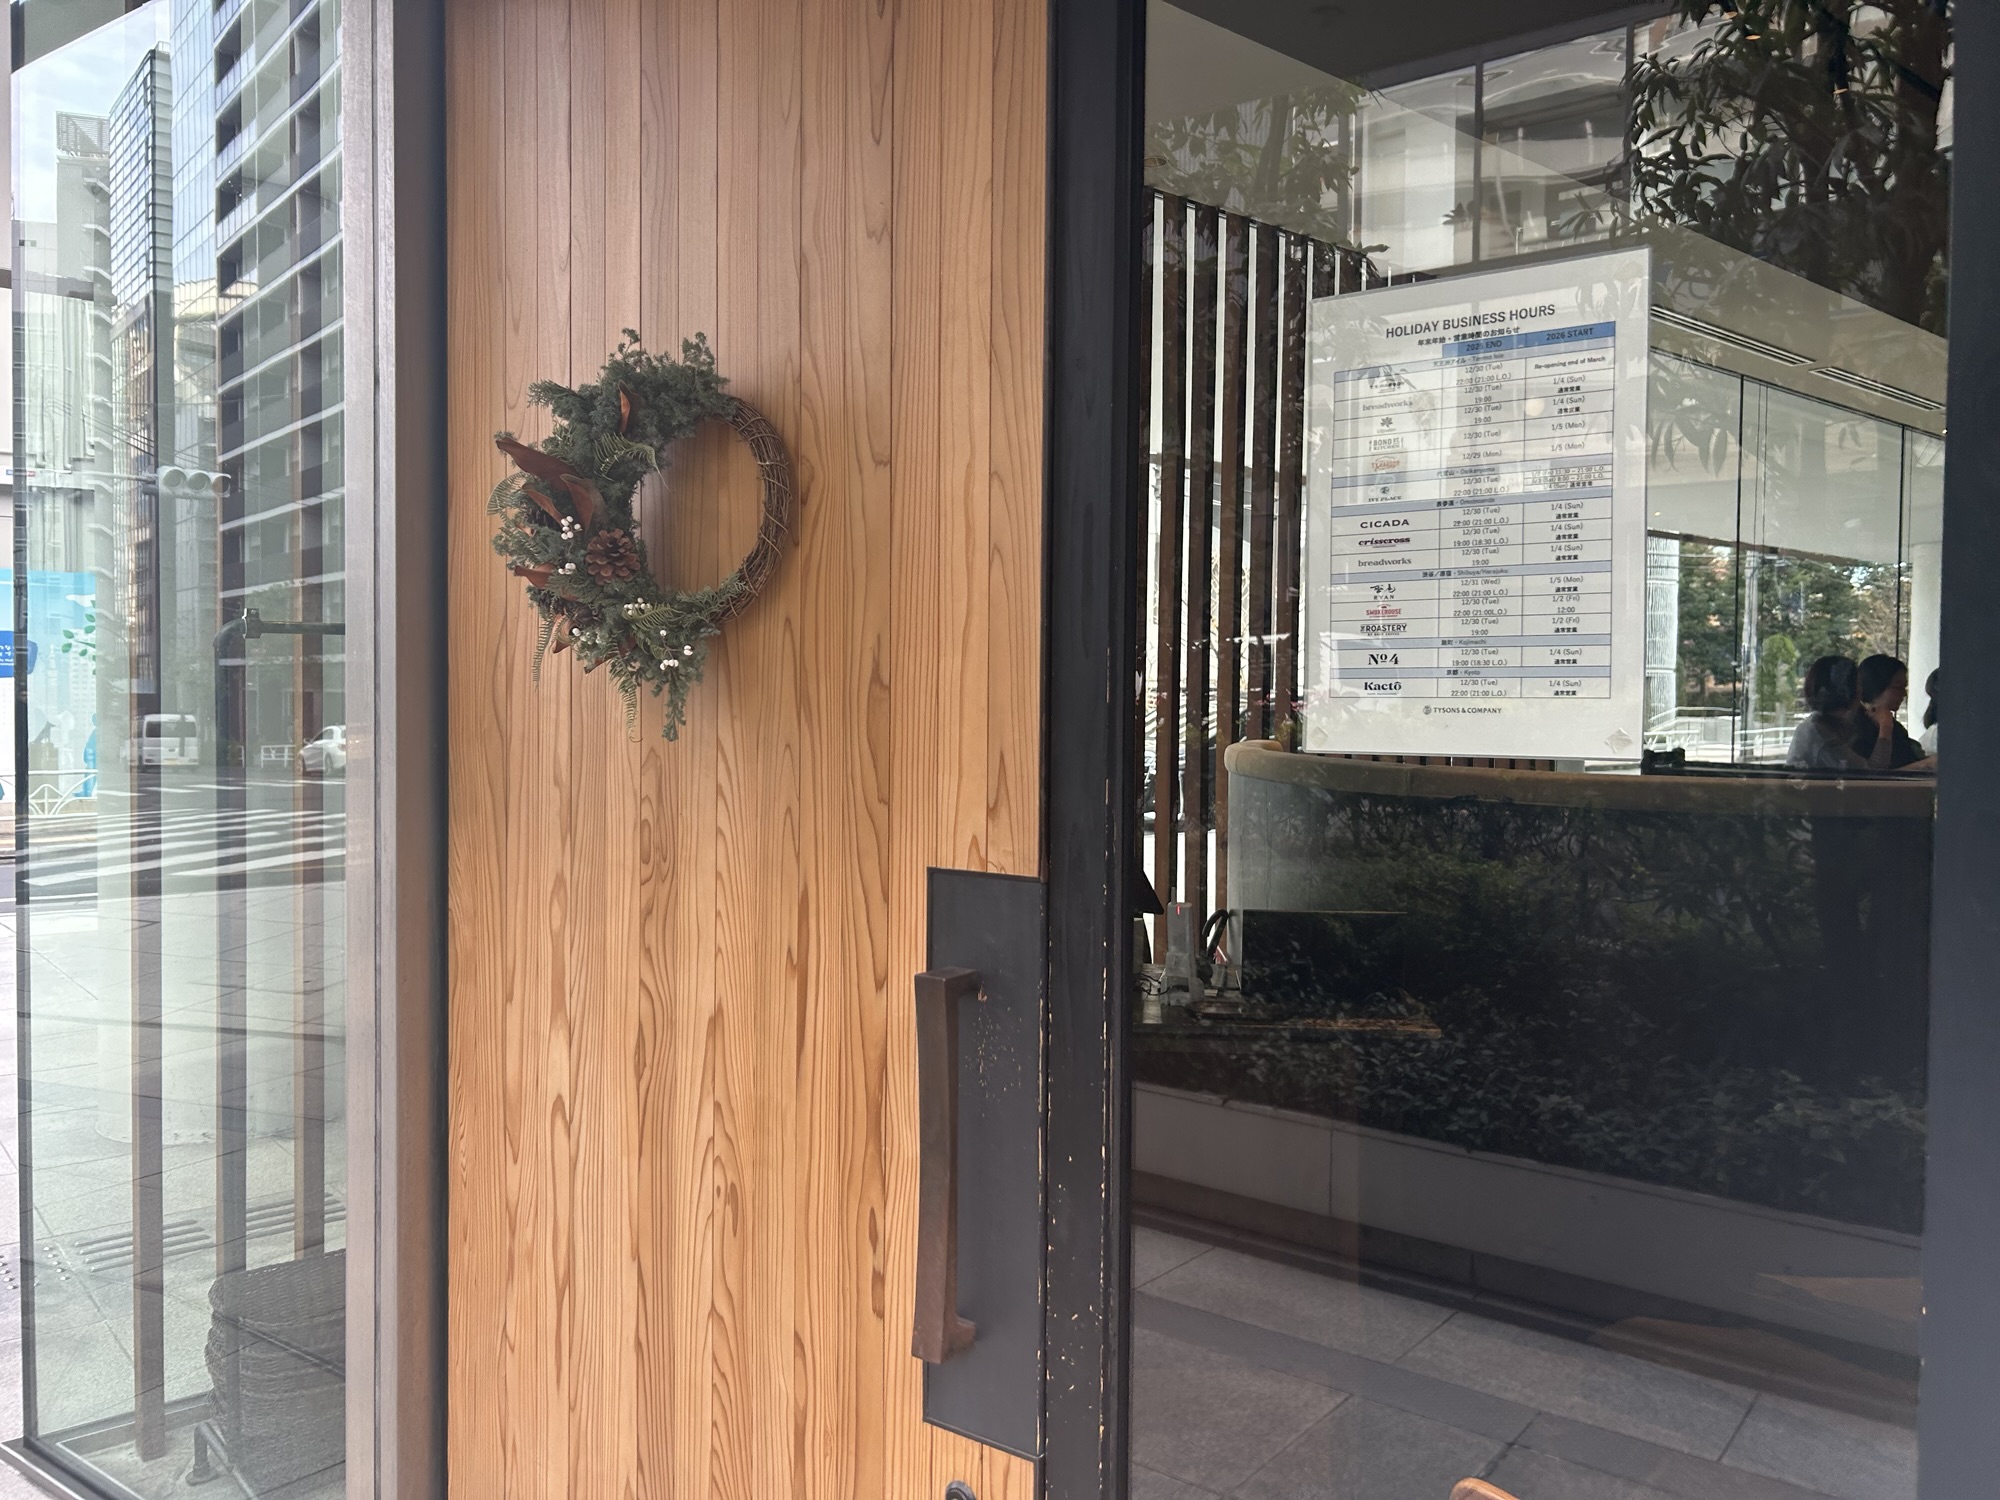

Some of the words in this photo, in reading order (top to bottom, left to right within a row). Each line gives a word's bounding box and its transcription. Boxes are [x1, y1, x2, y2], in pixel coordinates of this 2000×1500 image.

[1385, 320, 1440, 339] HOLIDAY
[1442, 311, 1505, 331] BUSINESS
[1509, 304, 1556, 322] HOURS
[1546, 331, 1566, 341] 2026
[1567, 327, 1594, 338] START
[1485, 340, 1503, 350] END
[1566, 374, 1586, 384] (Sun)
[1474, 395, 1492, 403] 19:00
[1566, 395, 1585, 404] (Sun)
[1551, 423, 1563, 431] 1/5
[1564, 420, 1586, 430] (Mon)
[1463, 431, 1482, 439] 12/30
[1373, 438, 1392, 446] BOND
[1551, 444, 1562, 452] 1/5
[1454, 488, 1471, 496] 22:00
[1564, 501, 1584, 510] (Sun)
[1462, 507, 1481, 515] 12/30
[1483, 506, 1501, 515] (Tue)
[1359, 519, 1410, 529] CICADA
[1472, 518, 1492, 526] (21:00
[1462, 528, 1481, 536] 12/30
[1482, 526, 1500, 535] (Tue)
[1550, 524, 1562, 532] 1/4
[1564, 522, 1583, 531] (Sun)
[1358, 537, 1411, 546] crisscross
[1471, 538, 1492, 546] (18:30
[1462, 548, 1480, 556] 12/30
[1482, 547, 1500, 555] (Tue)
[1564, 543, 1583, 552] (Sun)
[1358, 557, 1412, 567] breadworks
[1460, 578, 1479, 586] 12/31
[1480, 577, 1501, 585] (Wed)
[1563, 575, 1584, 584] (Mon)
[1471, 589, 1491, 597] (21:00
[1461, 598, 1480, 606] 12/30
[1481, 597, 1499, 605] (Tue)
[1565, 594, 1580, 602] (Fri)
[1481, 617, 1499, 625] (Tue)
[1565, 616, 1580, 624] (Fri)
[1365, 624, 1407, 632] ROASTERY
[1460, 648, 1479, 656] 12/30
[1480, 648, 1499, 656] (Tue)
[1563, 648, 1582, 656] (Sun)
[1470, 659, 1490, 667] (18:30
[1363, 681, 1402, 691] Kactô
[1480, 678, 1498, 686] (Tue)
[1562, 679, 1582, 687] (Sun)
[1469, 689, 1490, 697] (21:00
[1467, 706, 1502, 714] COMPANY
